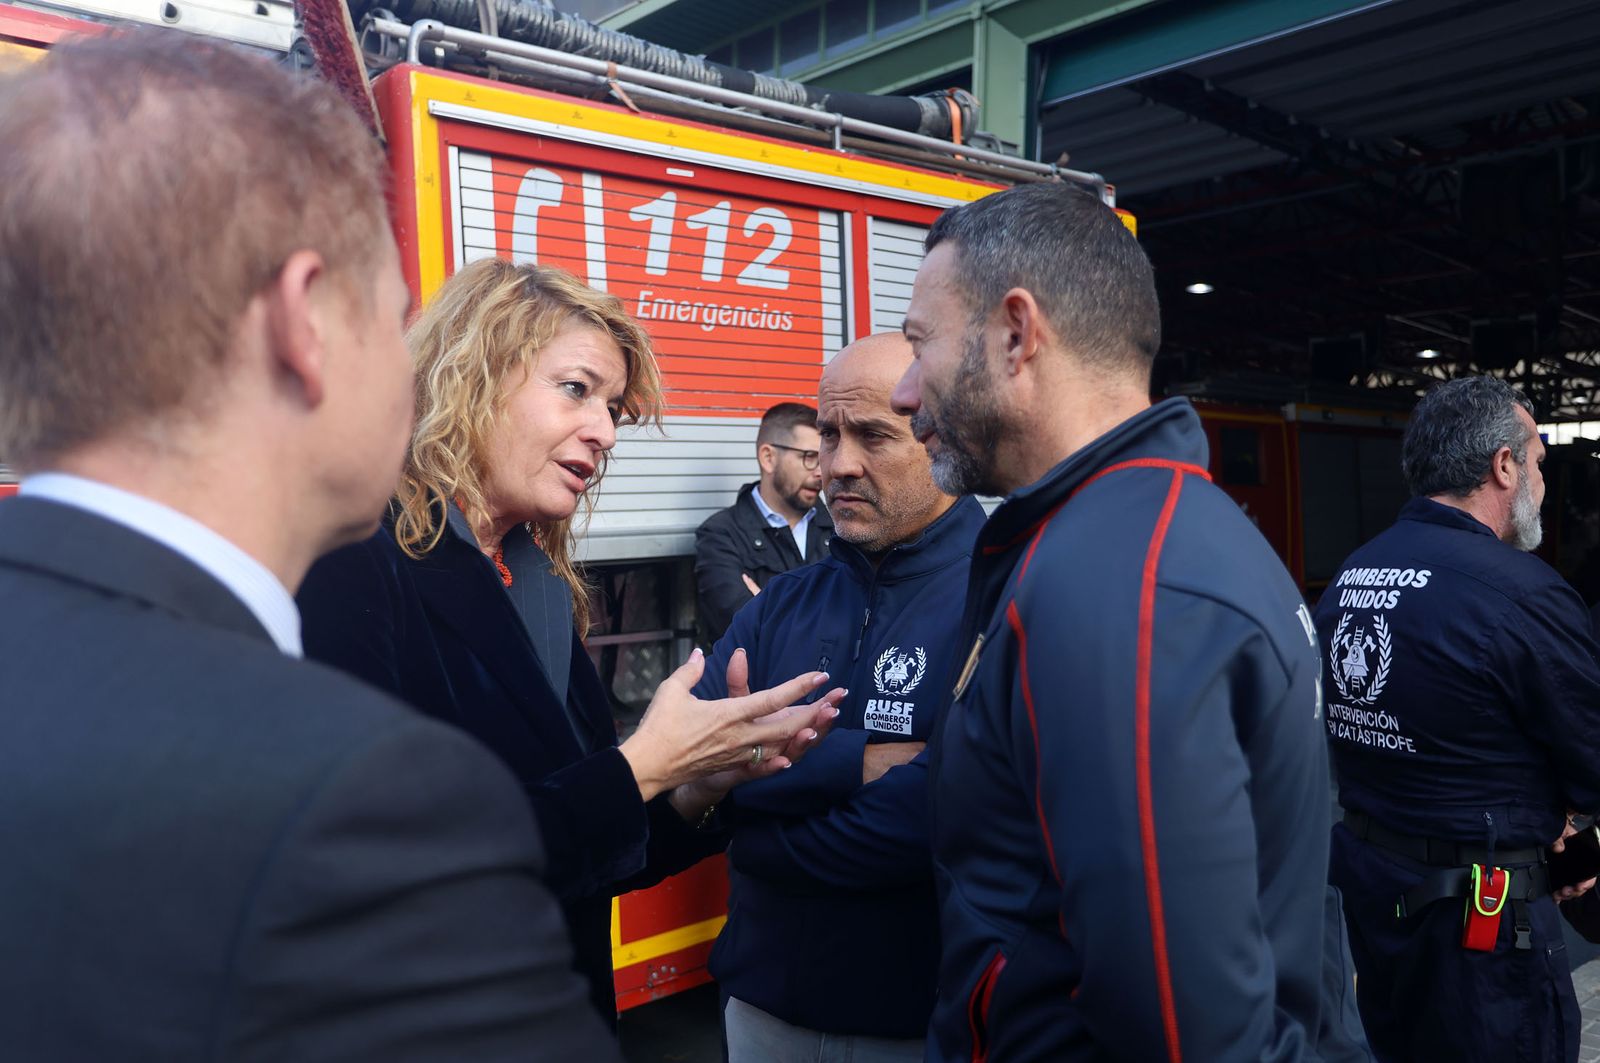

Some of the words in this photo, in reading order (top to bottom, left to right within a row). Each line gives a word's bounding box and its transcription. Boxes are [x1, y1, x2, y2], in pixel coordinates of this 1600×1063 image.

[628, 191, 793, 290] 112
[637, 290, 793, 332] Emergencias
[1336, 568, 1432, 588] BOMBEROS
[1339, 589, 1400, 609] UNIDOS
[865, 699, 914, 715] BUSF
[1328, 703, 1399, 731] INTERVENCIÓN
[865, 713, 910, 725] BOMBEROS
[873, 721, 904, 732] UNIDOS
[1338, 722, 1416, 752] CATÁSTROFE
